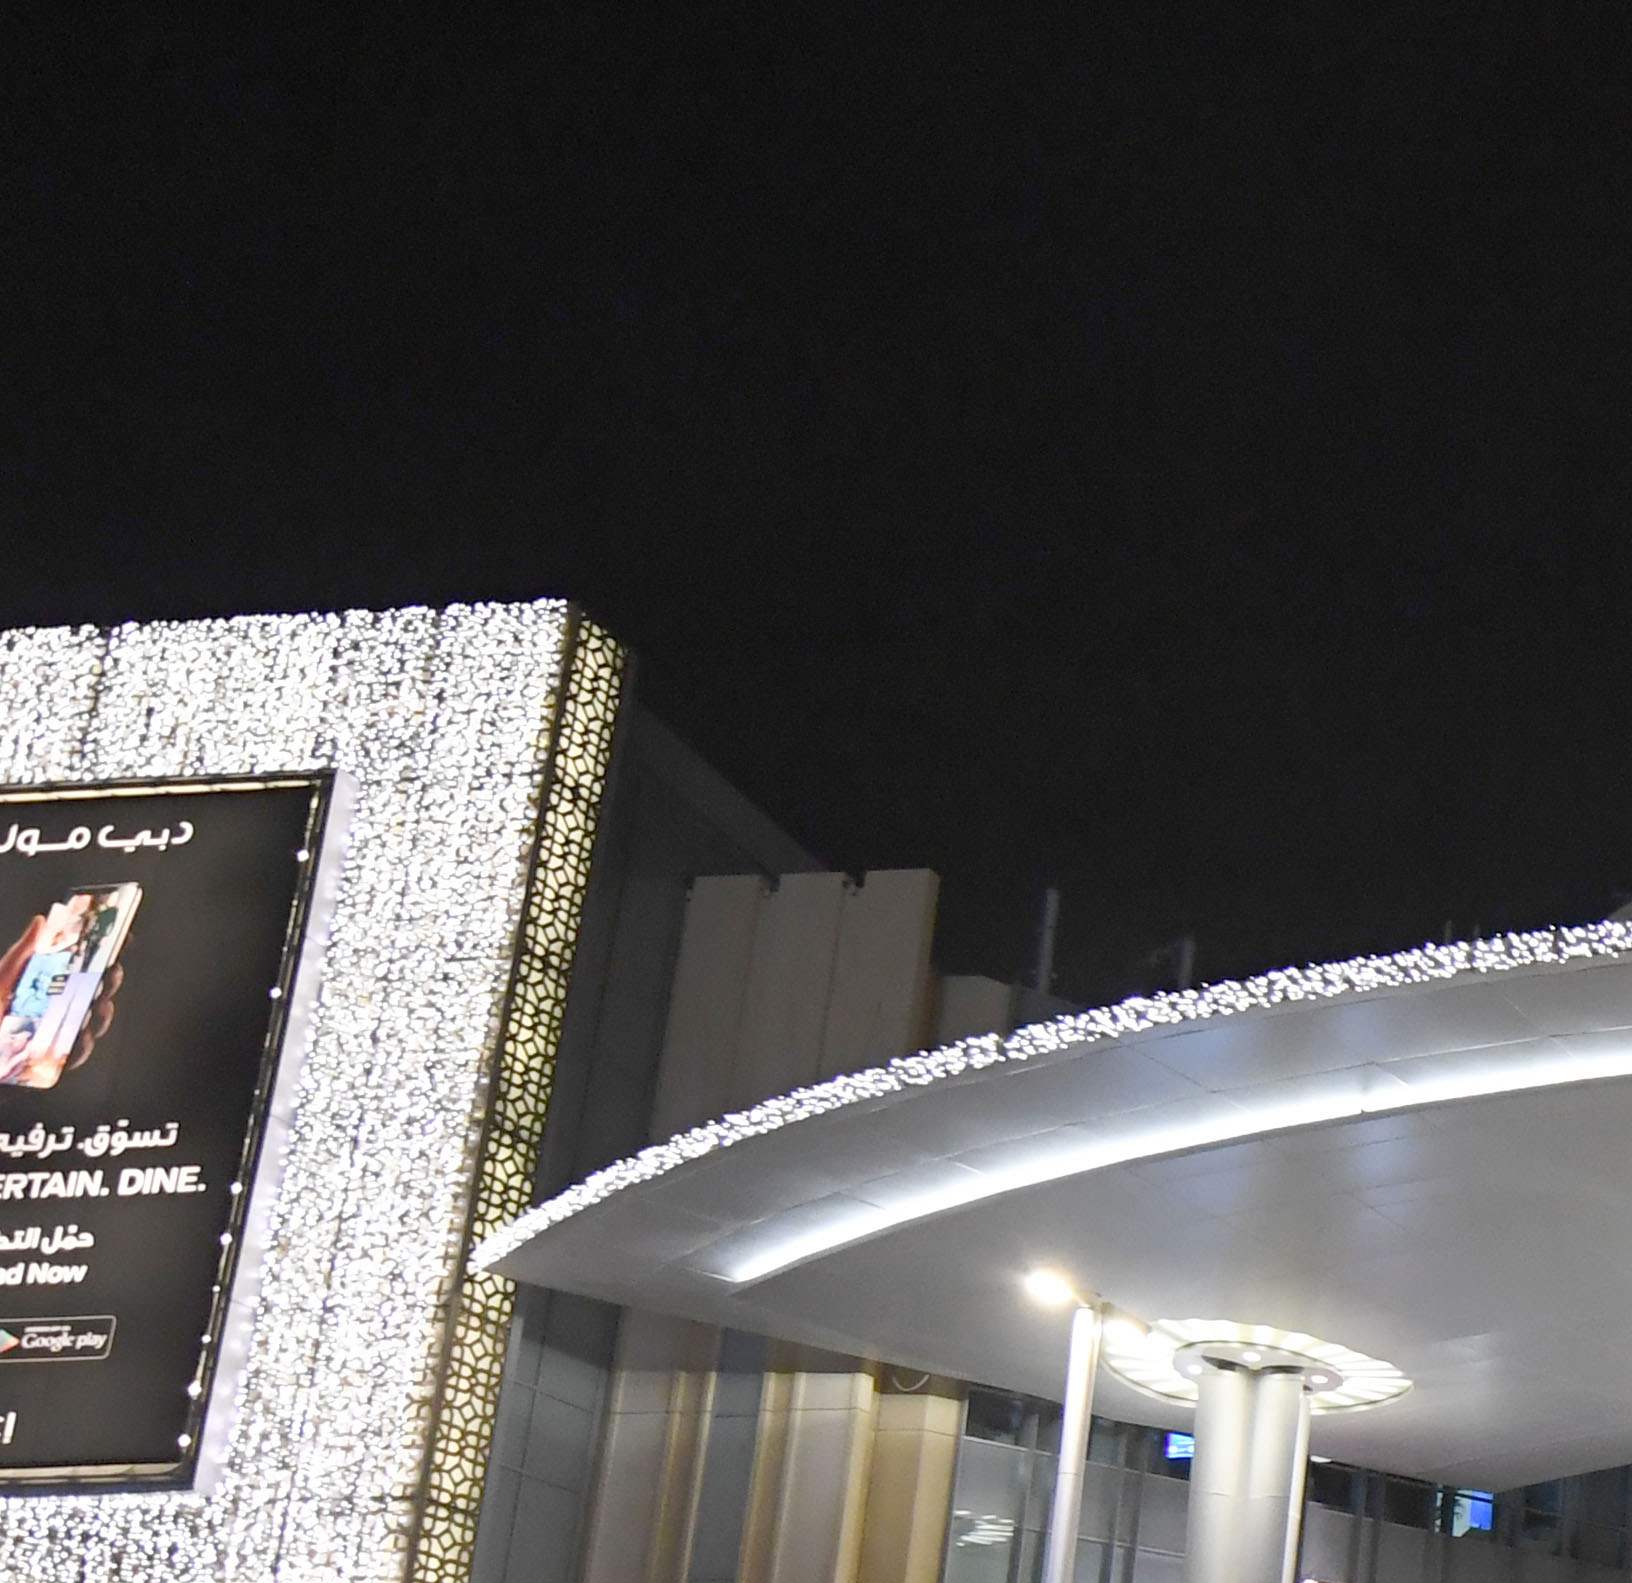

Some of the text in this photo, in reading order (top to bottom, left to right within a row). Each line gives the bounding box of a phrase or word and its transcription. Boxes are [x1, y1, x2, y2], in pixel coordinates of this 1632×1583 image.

[97, 821, 195, 853] دبي
[0, 1165, 207, 1199] RTAIN. DINE.
[26, 1262, 88, 1284] Now
[21, 1331, 107, 1352] Google play
